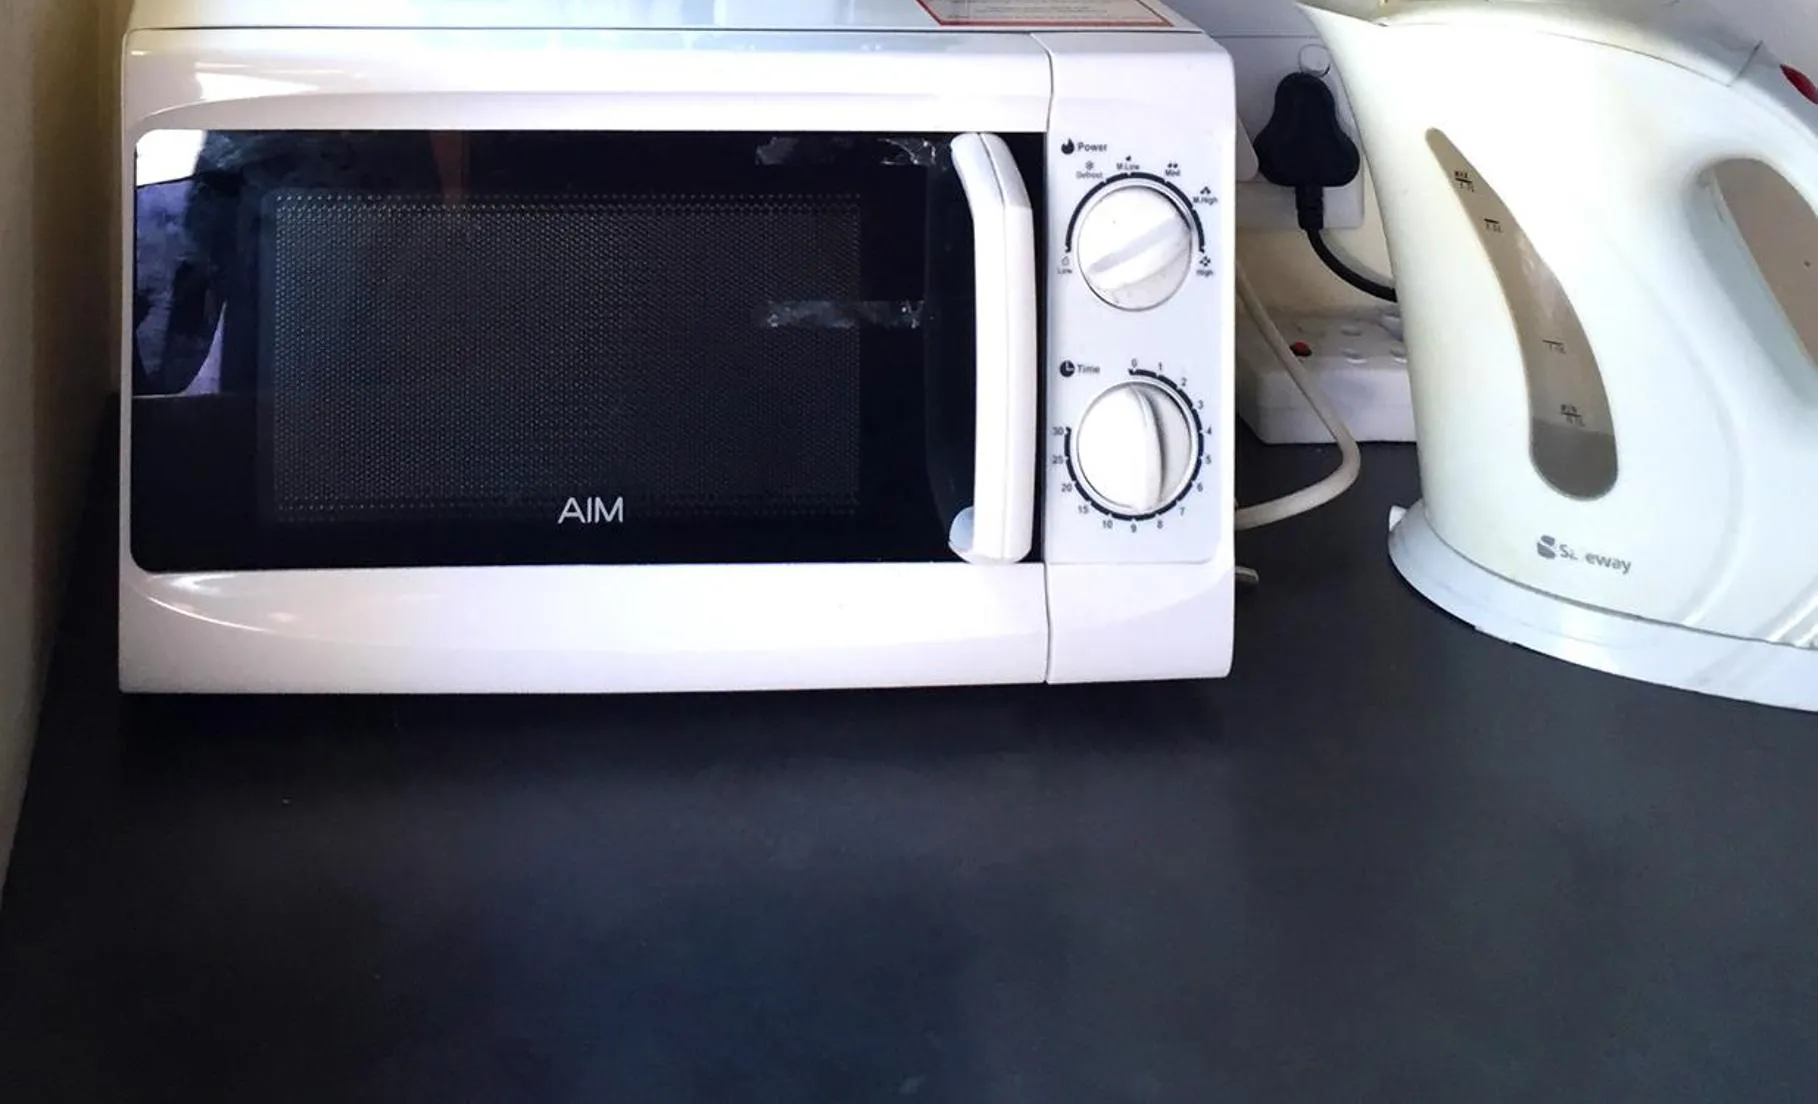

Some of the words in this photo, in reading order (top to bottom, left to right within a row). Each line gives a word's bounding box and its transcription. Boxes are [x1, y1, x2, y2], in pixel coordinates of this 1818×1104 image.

[1077, 142, 1107, 152] Power
[1131, 359, 1137, 367] 0
[1158, 362, 1162, 370] 1
[1077, 365, 1100, 373] Time
[1181, 378, 1187, 386] 2
[1198, 400, 1204, 409] 3
[1052, 427, 1064, 435] 30
[1206, 427, 1212, 435] 4
[1061, 484, 1072, 492] 20
[557, 496, 624, 524] AIM
[1078, 505, 1089, 514] 15
[1180, 507, 1185, 515] 7
[1102, 520, 1113, 528] 10
